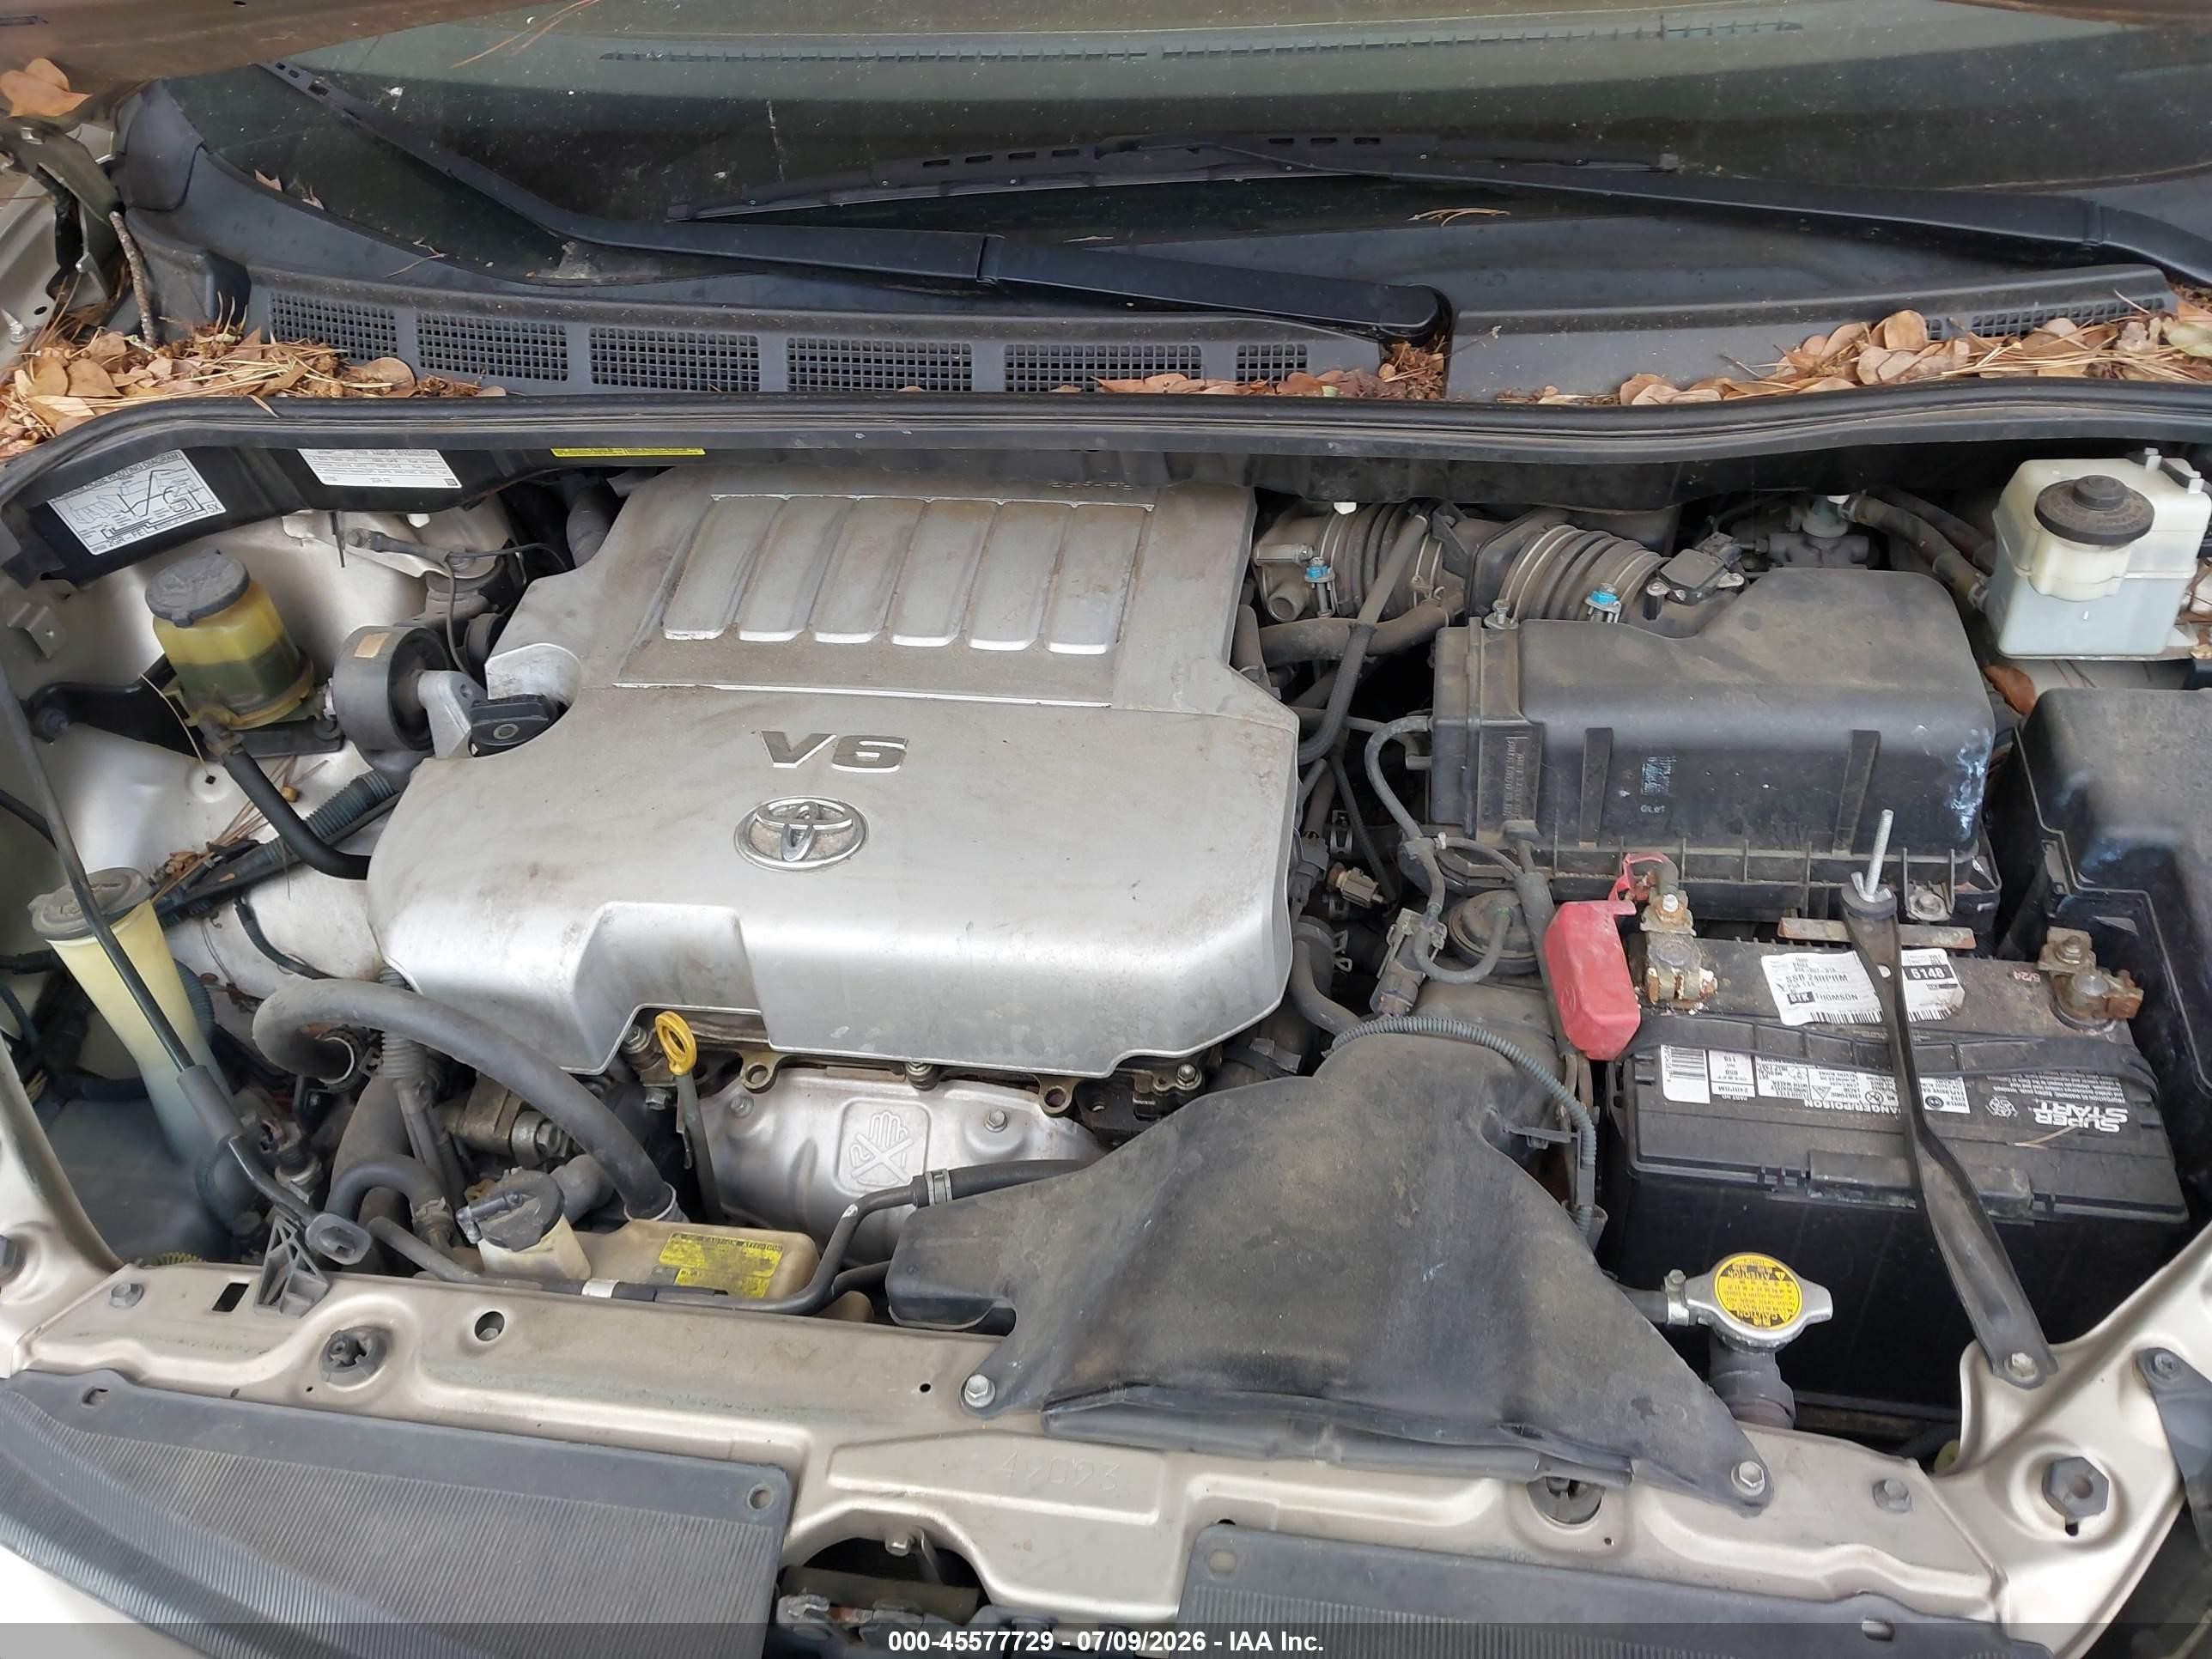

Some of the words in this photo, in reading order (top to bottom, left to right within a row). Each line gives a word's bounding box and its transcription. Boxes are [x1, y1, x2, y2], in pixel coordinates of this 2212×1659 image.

[759, 730, 908, 773] V6
[1814, 993, 1859, 1001] THOMSON
[1803, 1099, 1901, 1115] ANGER/POISON
[2033, 1101, 2129, 1124] START
[2034, 1111, 2120, 1133] SUPER
[1728, 1271, 1771, 1280] ATTENTION
[1736, 1310, 1778, 1321] CAUTION
